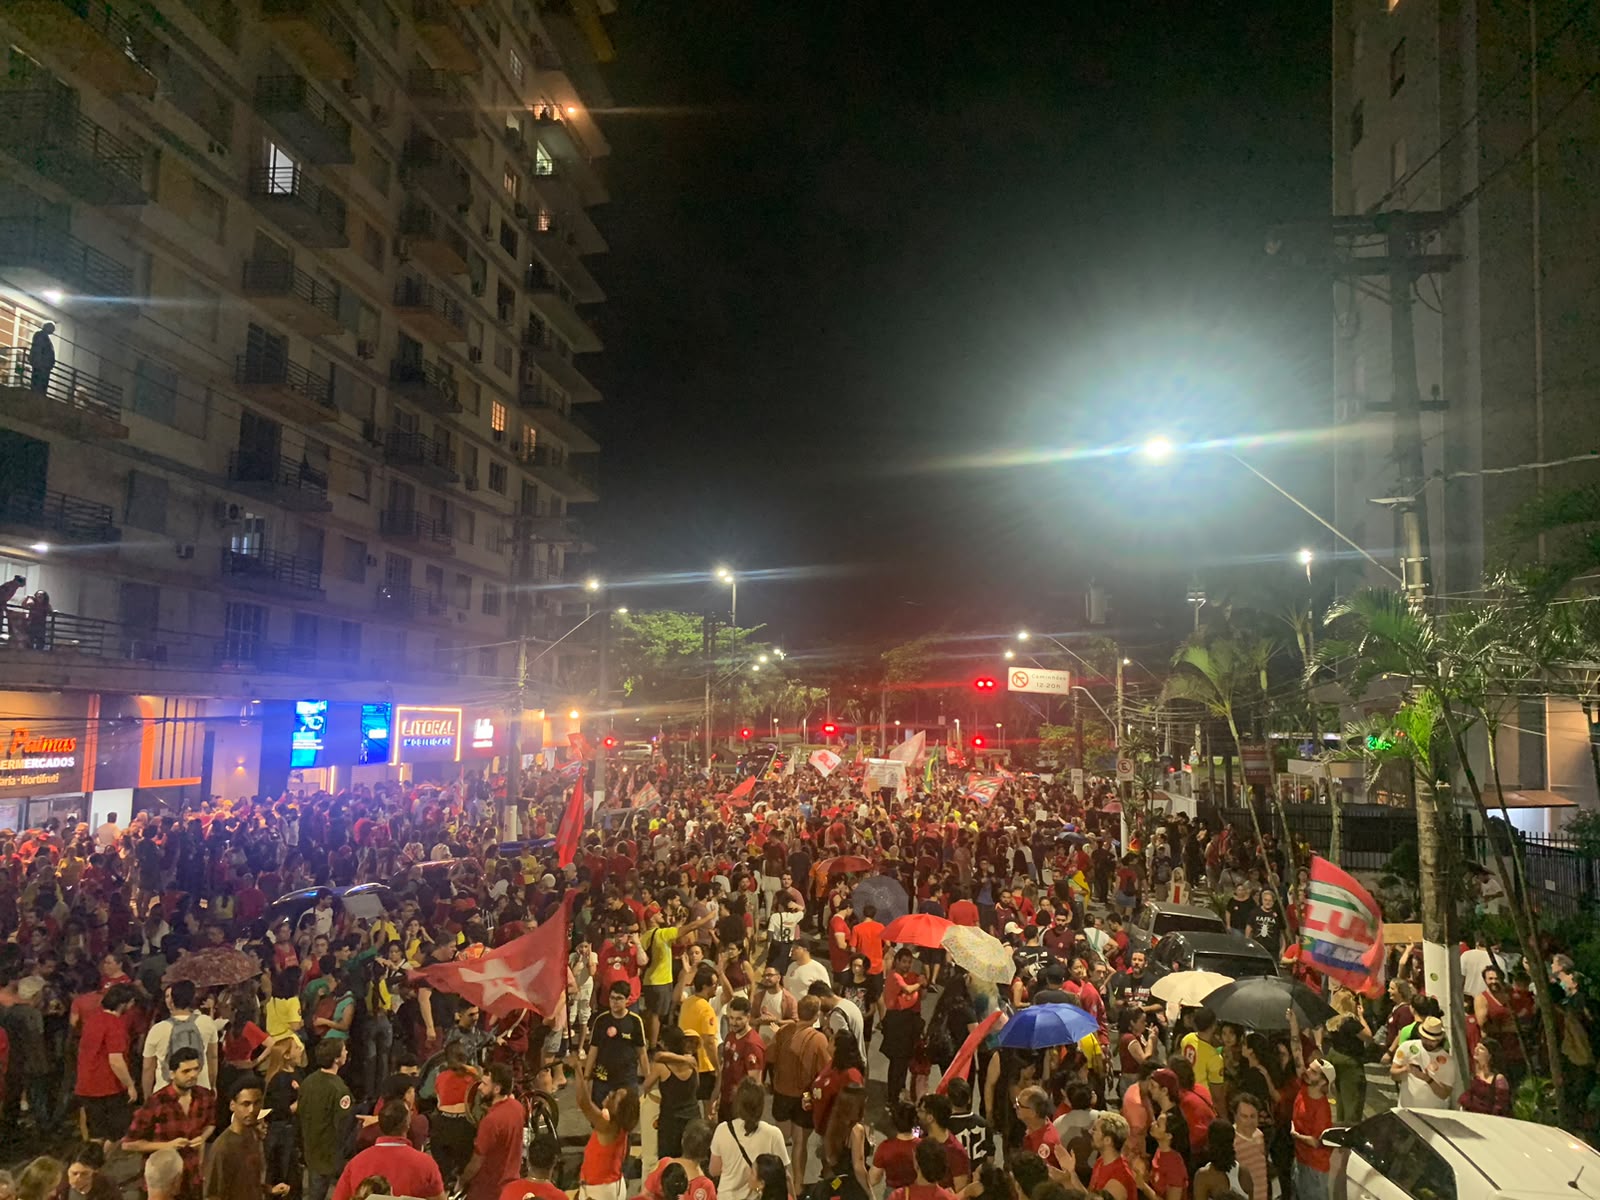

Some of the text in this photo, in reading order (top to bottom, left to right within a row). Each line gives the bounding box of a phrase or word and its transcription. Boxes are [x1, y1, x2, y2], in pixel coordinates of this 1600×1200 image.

[401, 720, 455, 736] LITORAL
[10, 728, 77, 754] Palmas
[0, 757, 75, 770] ERMERCADOS
[21, 773, 59, 784] Hortifruti
[1255, 916, 1276, 924] KAFKA
